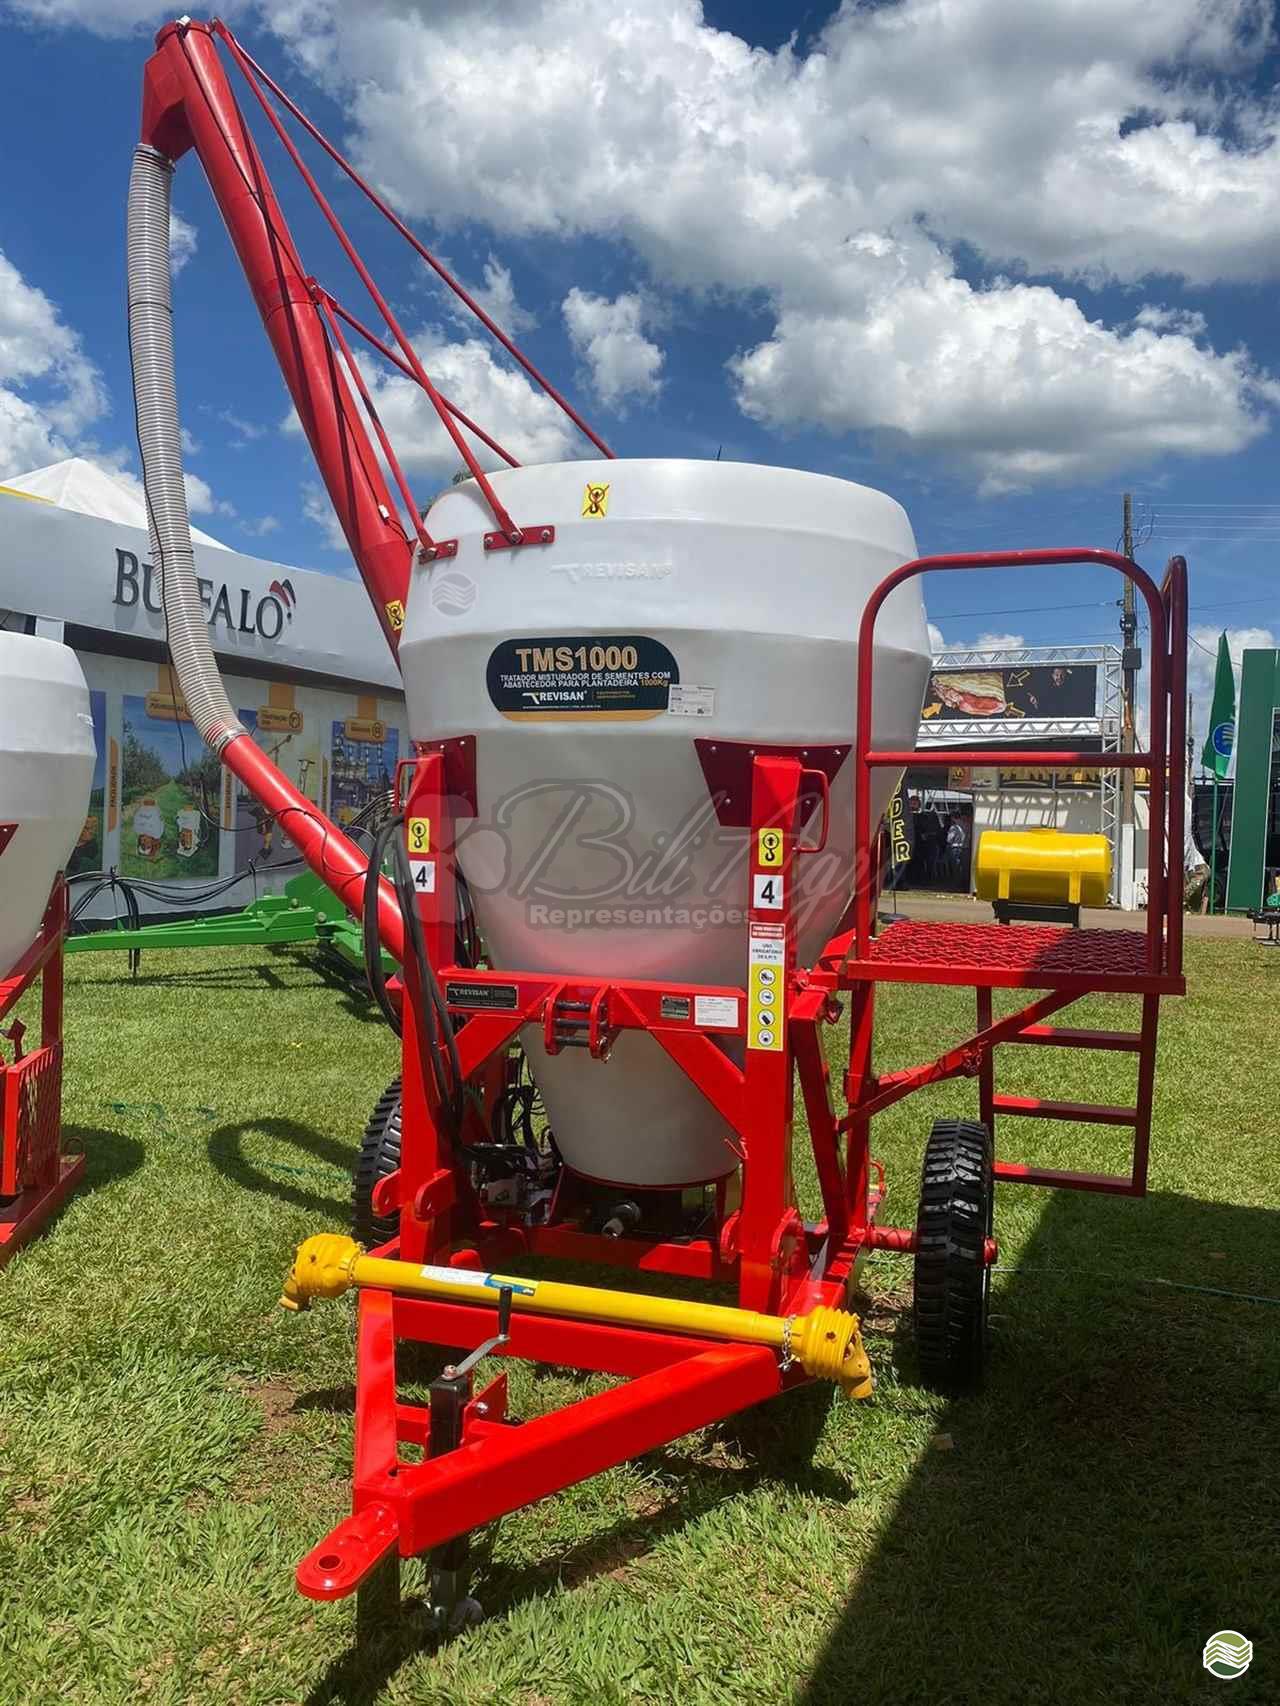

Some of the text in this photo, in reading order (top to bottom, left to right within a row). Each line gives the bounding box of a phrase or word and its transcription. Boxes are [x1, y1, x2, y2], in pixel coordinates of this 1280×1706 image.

[112, 547, 283, 639] BUFALO
[515, 645, 638, 672] TMS1000
[500, 671, 671, 682] TRATADOR MISTURADOR DE SEMENTES COM
[503, 680, 557, 688] ABASTECEDOR
[558, 680, 580, 688] PARA
[580, 679, 639, 687] PLANTADEIRA
[415, 865, 428, 887] 4
[760, 879, 775, 904] 4
